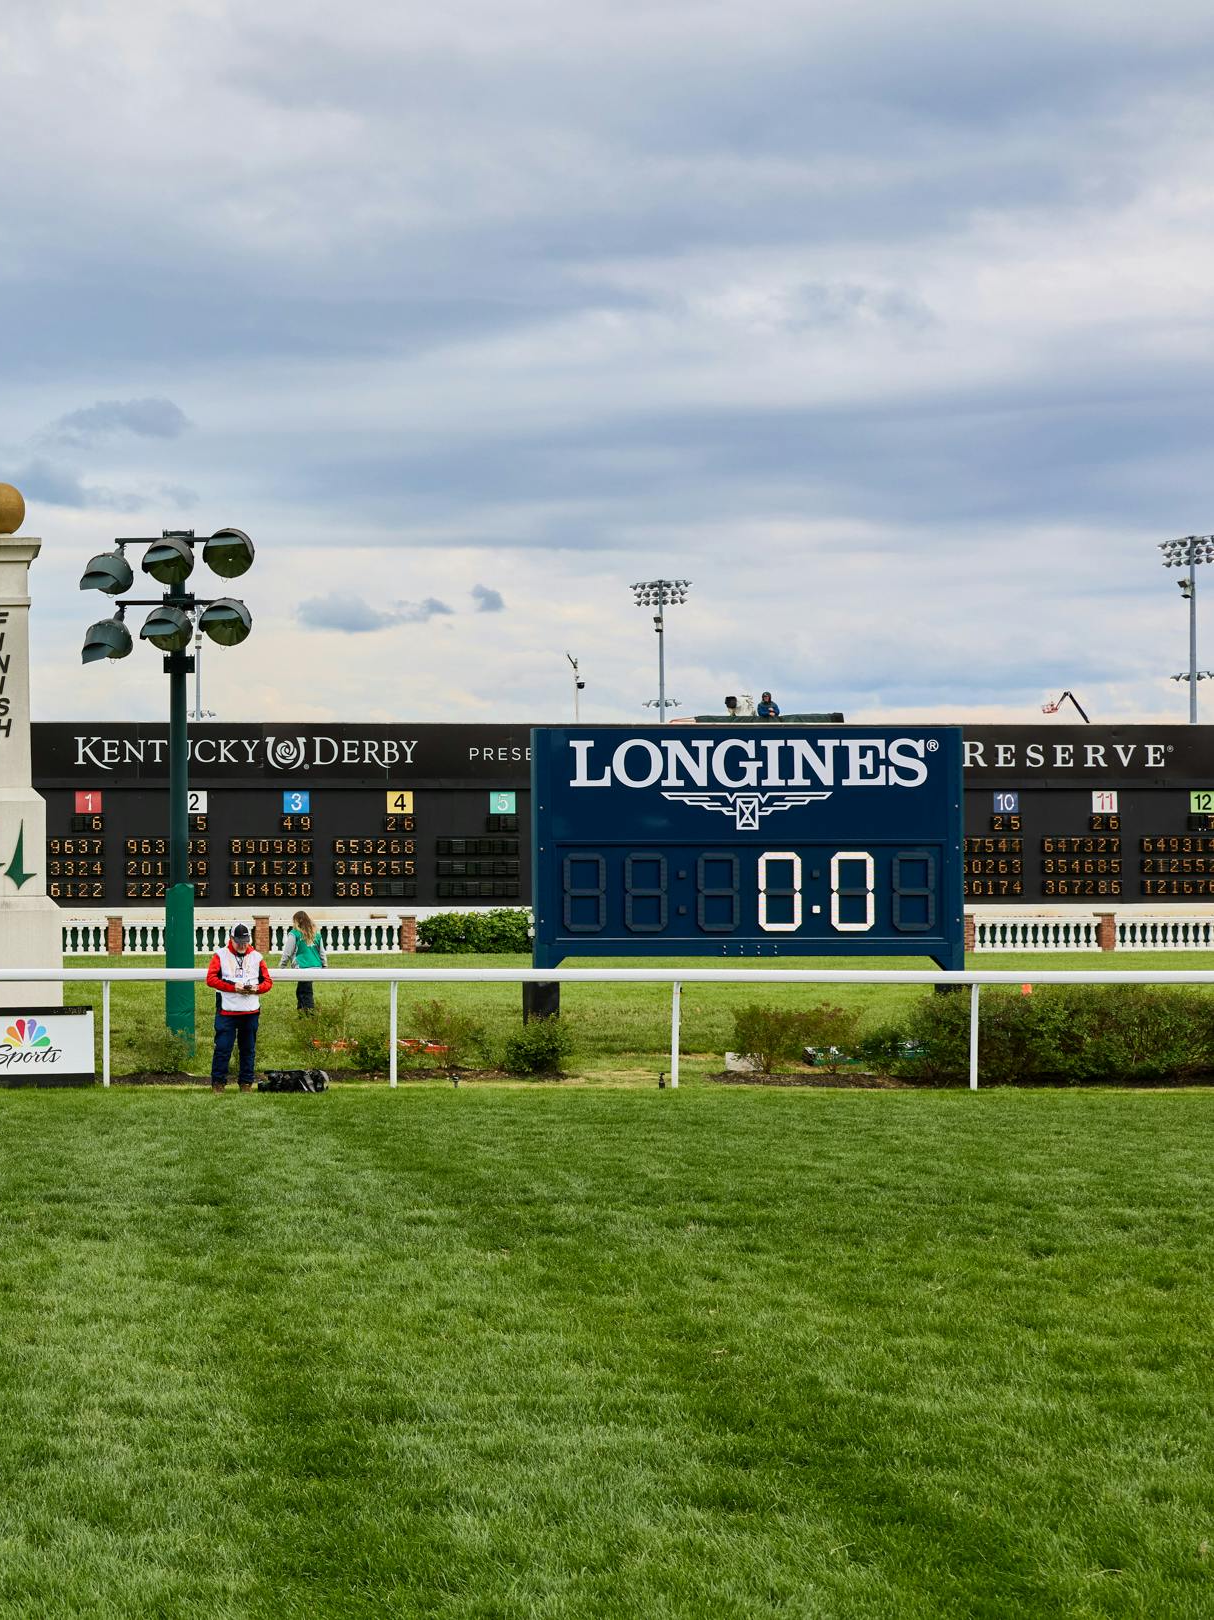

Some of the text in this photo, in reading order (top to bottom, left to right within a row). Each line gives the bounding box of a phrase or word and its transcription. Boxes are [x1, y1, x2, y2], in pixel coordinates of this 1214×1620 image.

[74, 735, 532, 770] KENTCKY DERBY PRESE
[84, 794, 92, 811] 1
[189, 794, 199, 811] 2
[291, 793, 302, 811] 3
[394, 794, 406, 811] 4
[497, 793, 509, 811] 5
[997, 794, 1015, 811] 10
[1097, 793, 1113, 810] 11
[1194, 794, 1212, 811] 12
[92, 816, 102, 830] 6
[196, 816, 206, 830] 5
[50, 840, 102, 854] 9637
[336, 840, 414, 854] 653268
[50, 862, 102, 875] 3324
[50, 883, 102, 897] 6122
[336, 882, 373, 897] 386
